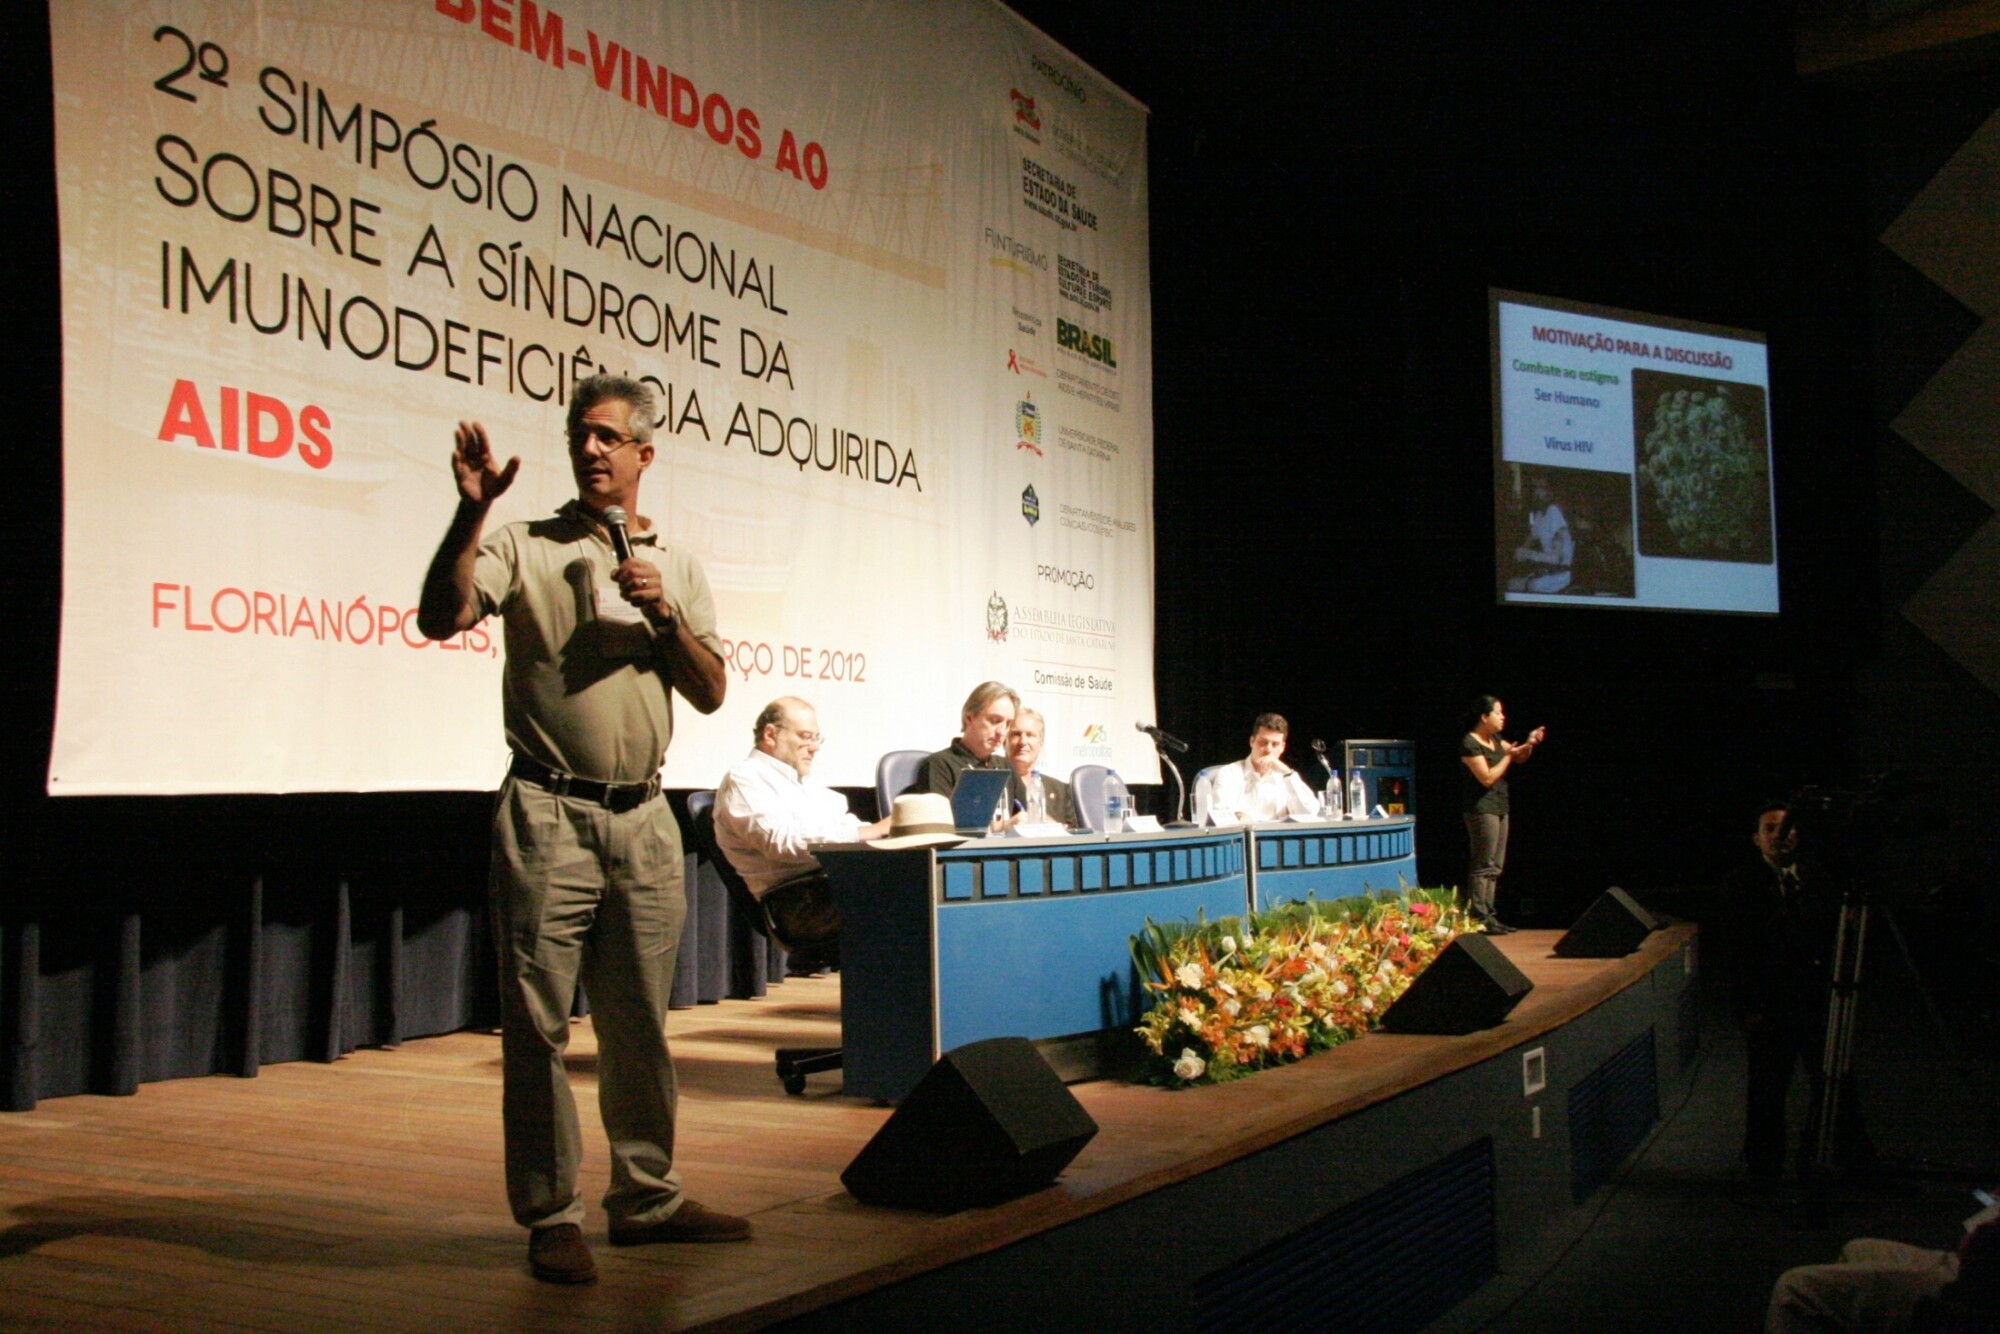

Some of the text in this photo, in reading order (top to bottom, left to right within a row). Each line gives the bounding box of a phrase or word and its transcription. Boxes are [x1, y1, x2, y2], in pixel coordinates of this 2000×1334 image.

[154, 25, 788, 315] 2º SIMPÓSIO NACIONAL
[776, 128, 829, 190] AO
[1023, 157, 1077, 199] SECRETARIA DE
[1023, 176, 1098, 232] ESTADO DA SAÚDE
[155, 134, 794, 390] SOBRE A SÍNDROME DA
[1057, 317, 1117, 369] BRASIL
[1531, 325, 1733, 370] MOTIVAÇÃO PARA A DISCUSSÃO
[161, 240, 922, 492] IMUNODEFICIÊCIA ADQUIRIDA
[1512, 358, 1562, 377] Combate
[1563, 368, 1577, 380] ao
[1534, 387, 1601, 409] Ser Humano
[158, 379, 333, 469] AIDS
[1574, 438, 1595, 454] HIV
[1037, 565, 1095, 591] PROMOÇÃO
[1012, 627, 1028, 639] DO
[1013, 606, 1116, 633] ASSEMBLEIA LEGISLATIVA
[721, 640, 774, 682] RÇO
[783, 646, 813, 679] DE
[819, 650, 866, 683] 2012
[1034, 669, 1113, 691] Comissão de Saúde
